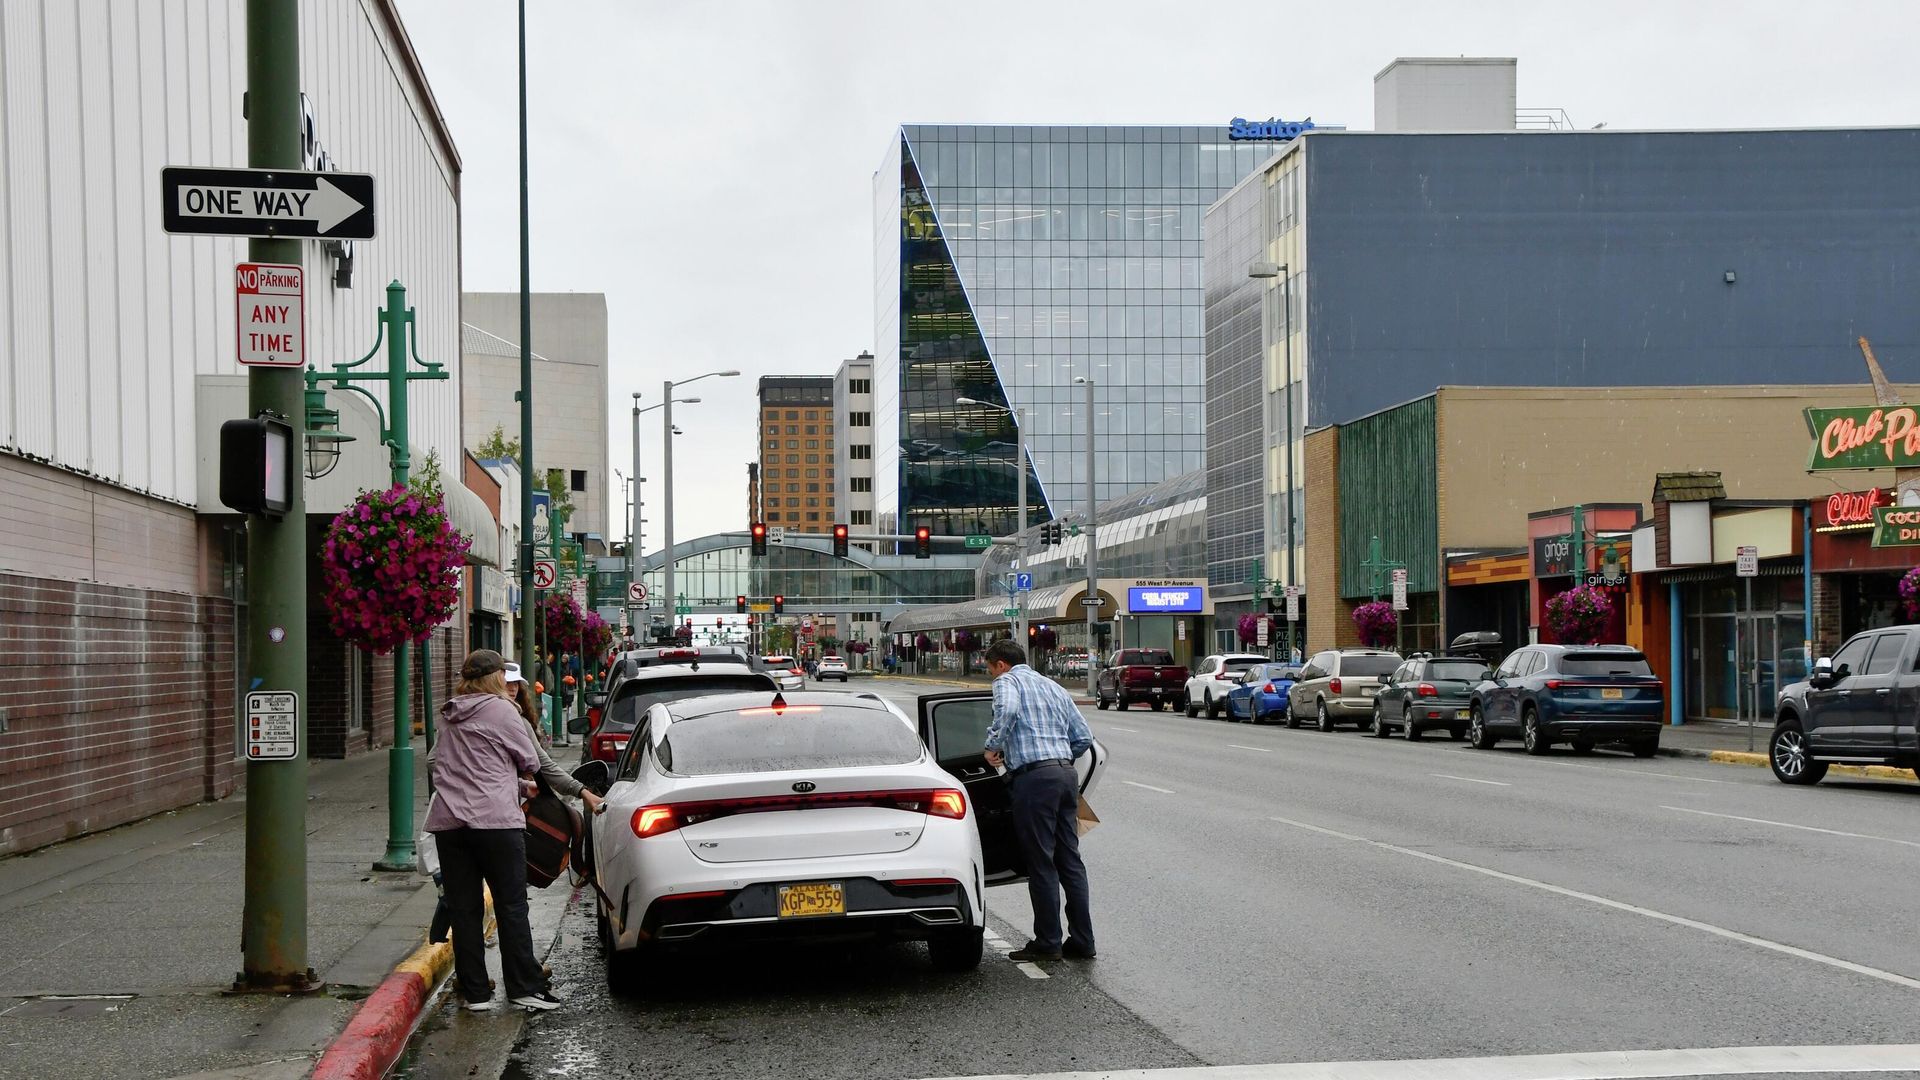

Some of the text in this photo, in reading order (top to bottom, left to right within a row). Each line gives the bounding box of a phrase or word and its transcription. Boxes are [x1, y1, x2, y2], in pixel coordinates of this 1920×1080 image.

[186, 188, 311, 217] ONE WAY
[237, 269, 299, 289] NO PARKING
[251, 304, 289, 324] ANY
[249, 333, 293, 352] TIME
[1821, 409, 1884, 458] Club
[1544, 539, 1569, 563] ginger
[1587, 573, 1627, 587] ginger
[1275, 631, 1303, 640] PIZA
[1276, 640, 1303, 651] CIDR
[795, 783, 813, 791] KIA
[793, 885, 828, 893] ALASKA
[780, 890, 842, 912] KGP 559
